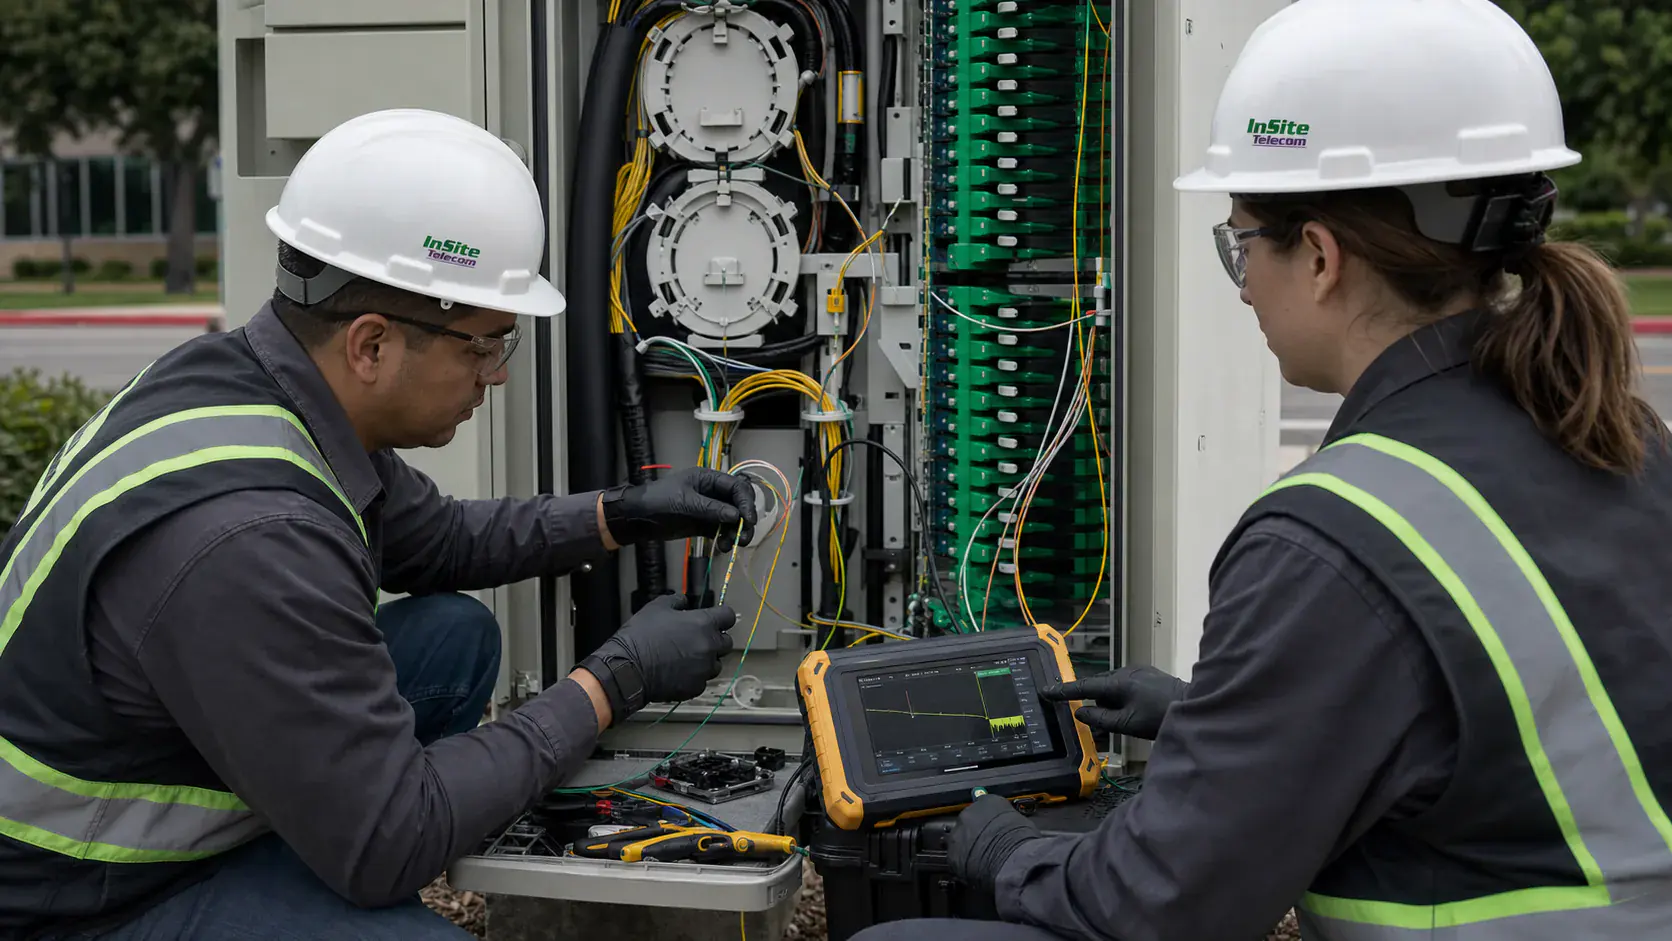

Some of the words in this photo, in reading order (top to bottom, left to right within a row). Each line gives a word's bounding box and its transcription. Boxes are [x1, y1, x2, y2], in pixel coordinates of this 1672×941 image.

[1247, 118, 1309, 135] InSite
[1253, 135, 1306, 146] Telecom
[423, 236, 480, 258] InSite
[428, 249, 476, 266] Telecom
